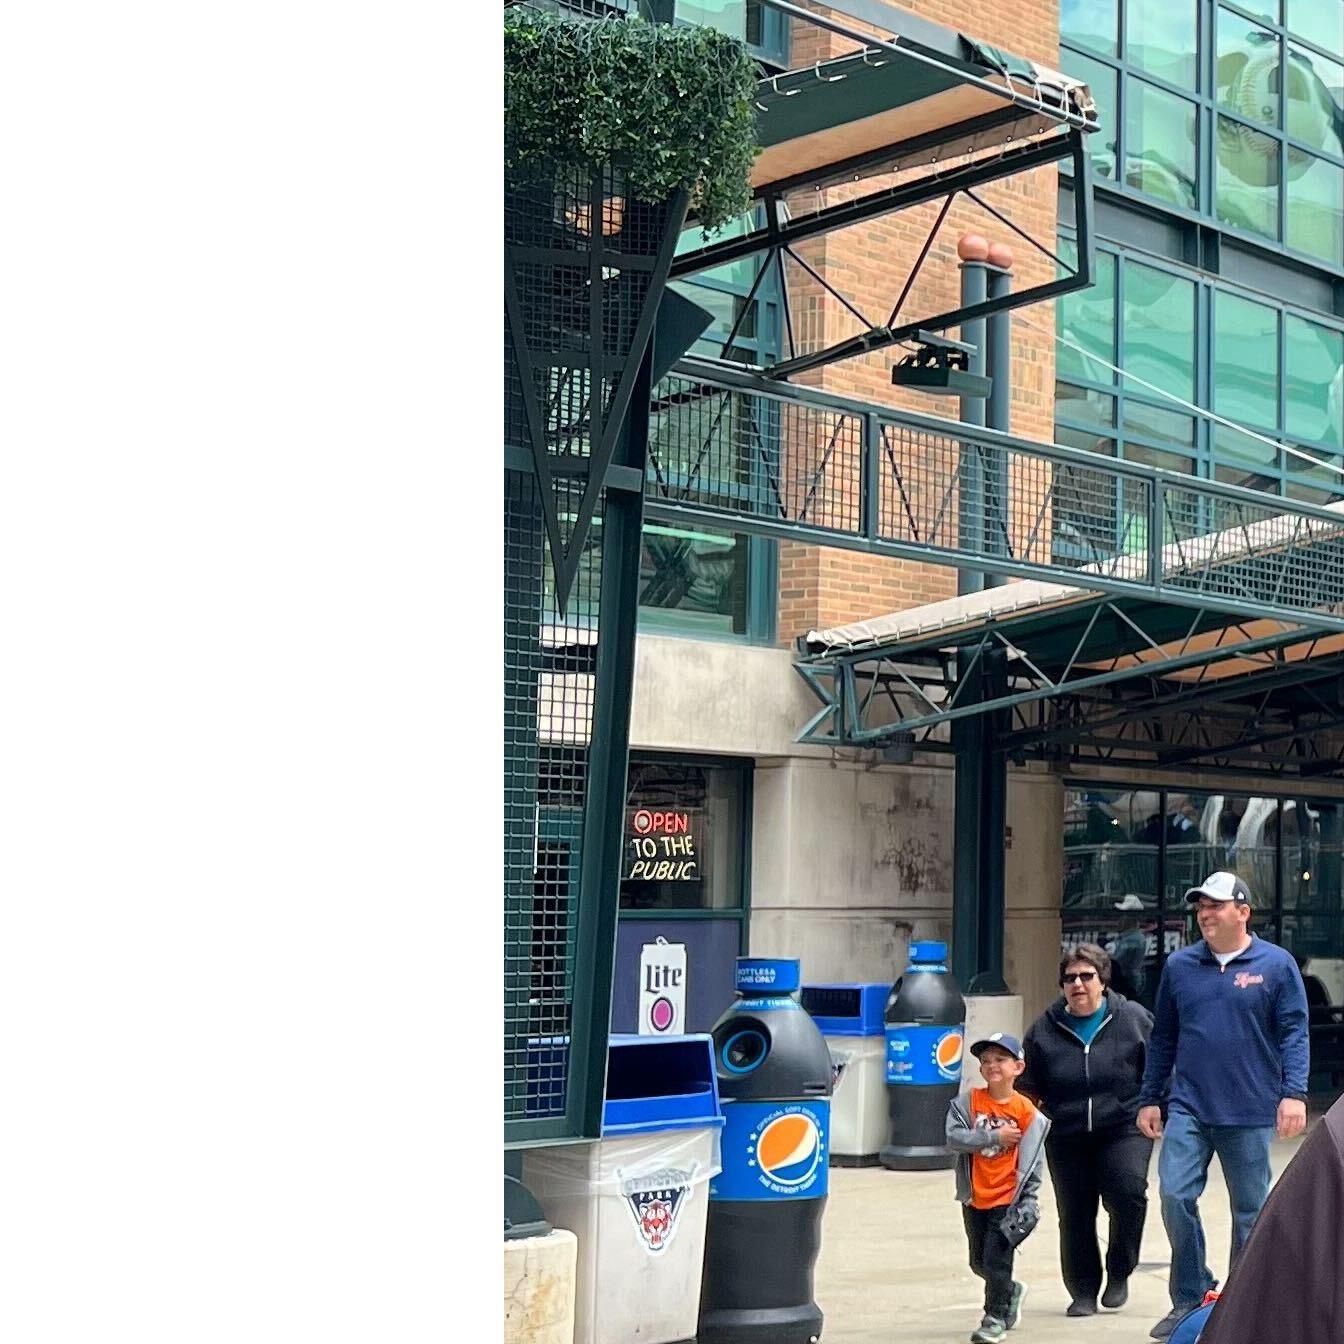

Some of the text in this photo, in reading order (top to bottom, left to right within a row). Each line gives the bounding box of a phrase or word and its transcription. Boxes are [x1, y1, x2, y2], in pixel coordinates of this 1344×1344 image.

[634, 809, 688, 834] OPEN
[632, 835, 695, 858] TO THE
[629, 860, 696, 881] PUBLIC
[645, 964, 682, 995] Lite
[640, 1190, 672, 1201] PARK
